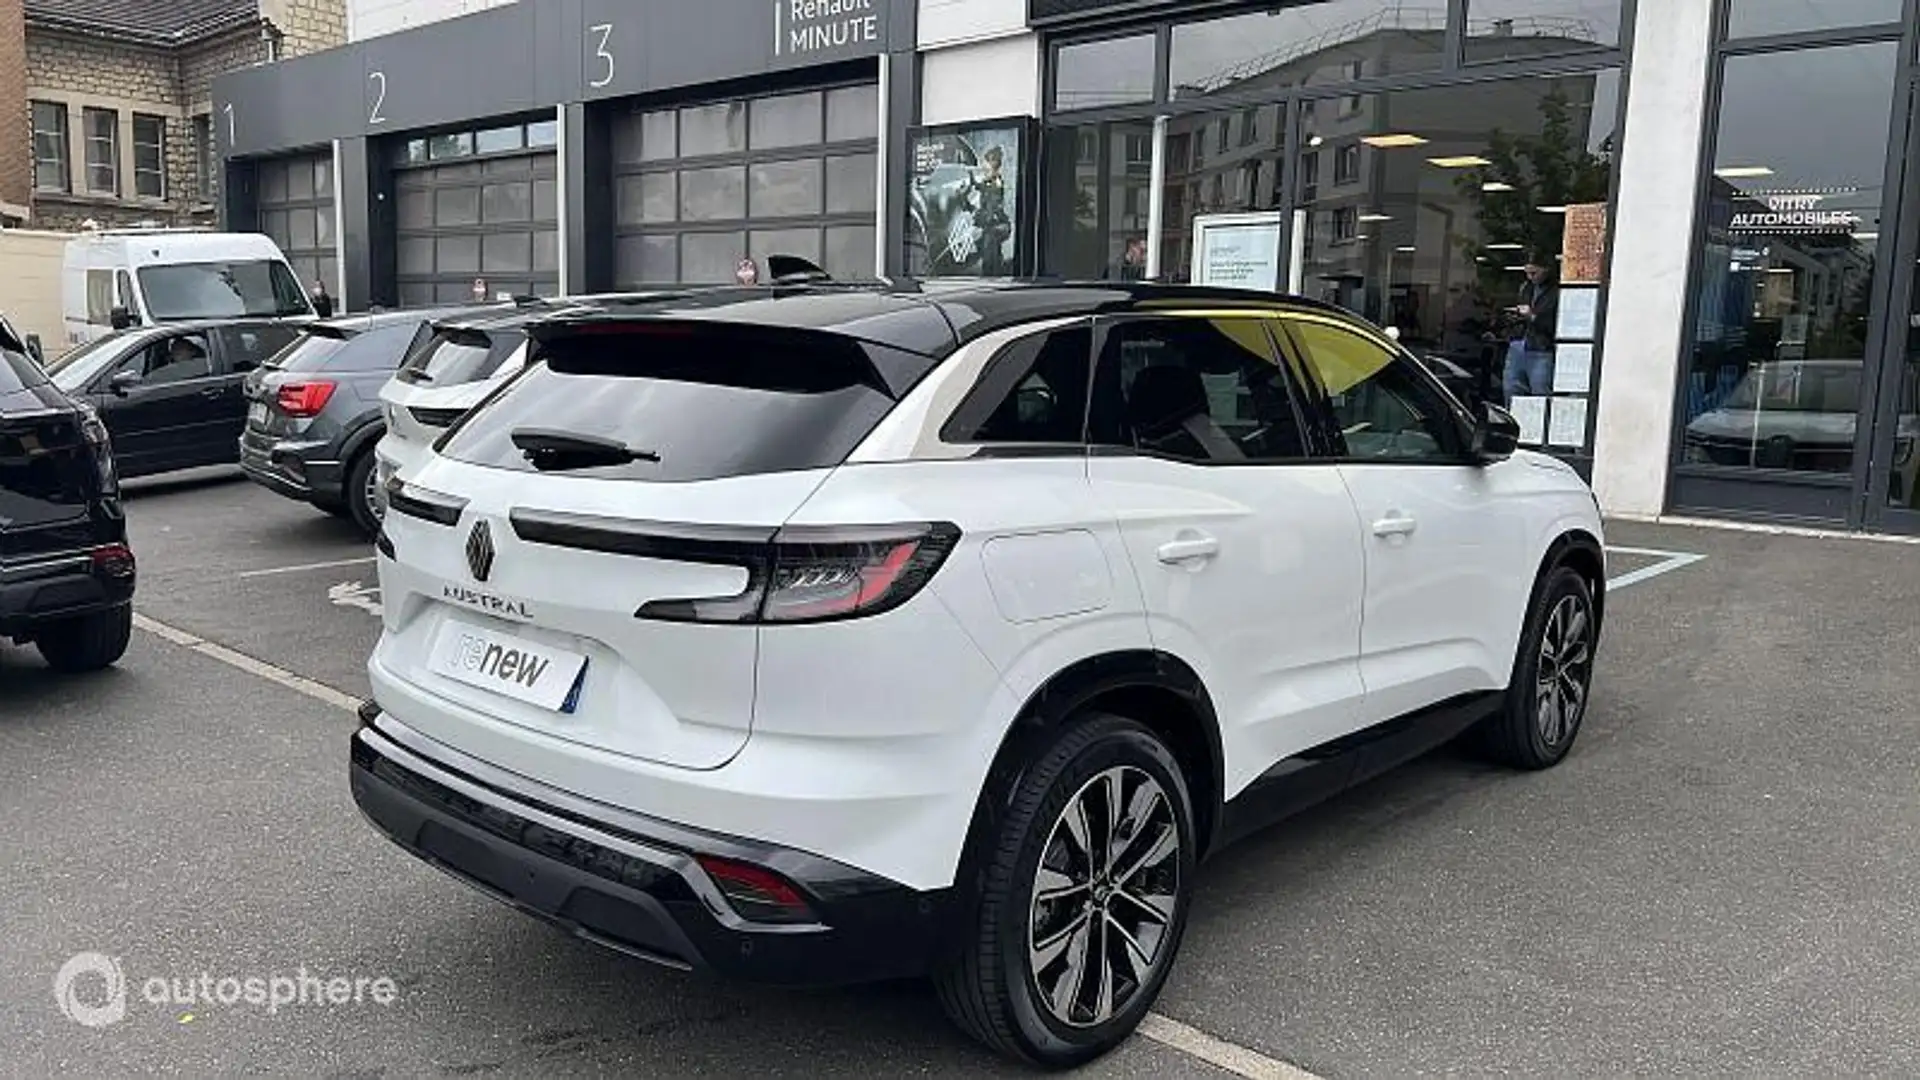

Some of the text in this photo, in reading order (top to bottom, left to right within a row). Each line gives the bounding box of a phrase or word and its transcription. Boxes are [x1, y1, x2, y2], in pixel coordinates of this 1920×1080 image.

[790, 14, 877, 53] MINUTE
[590, 24, 613, 87] 3
[369, 72, 386, 123] 2
[223, 103, 235, 146] 1
[1731, 211, 1852, 226] AUTOMOBILES
[443, 586, 534, 618] AUSTRAL
[447, 633, 549, 688] renew
